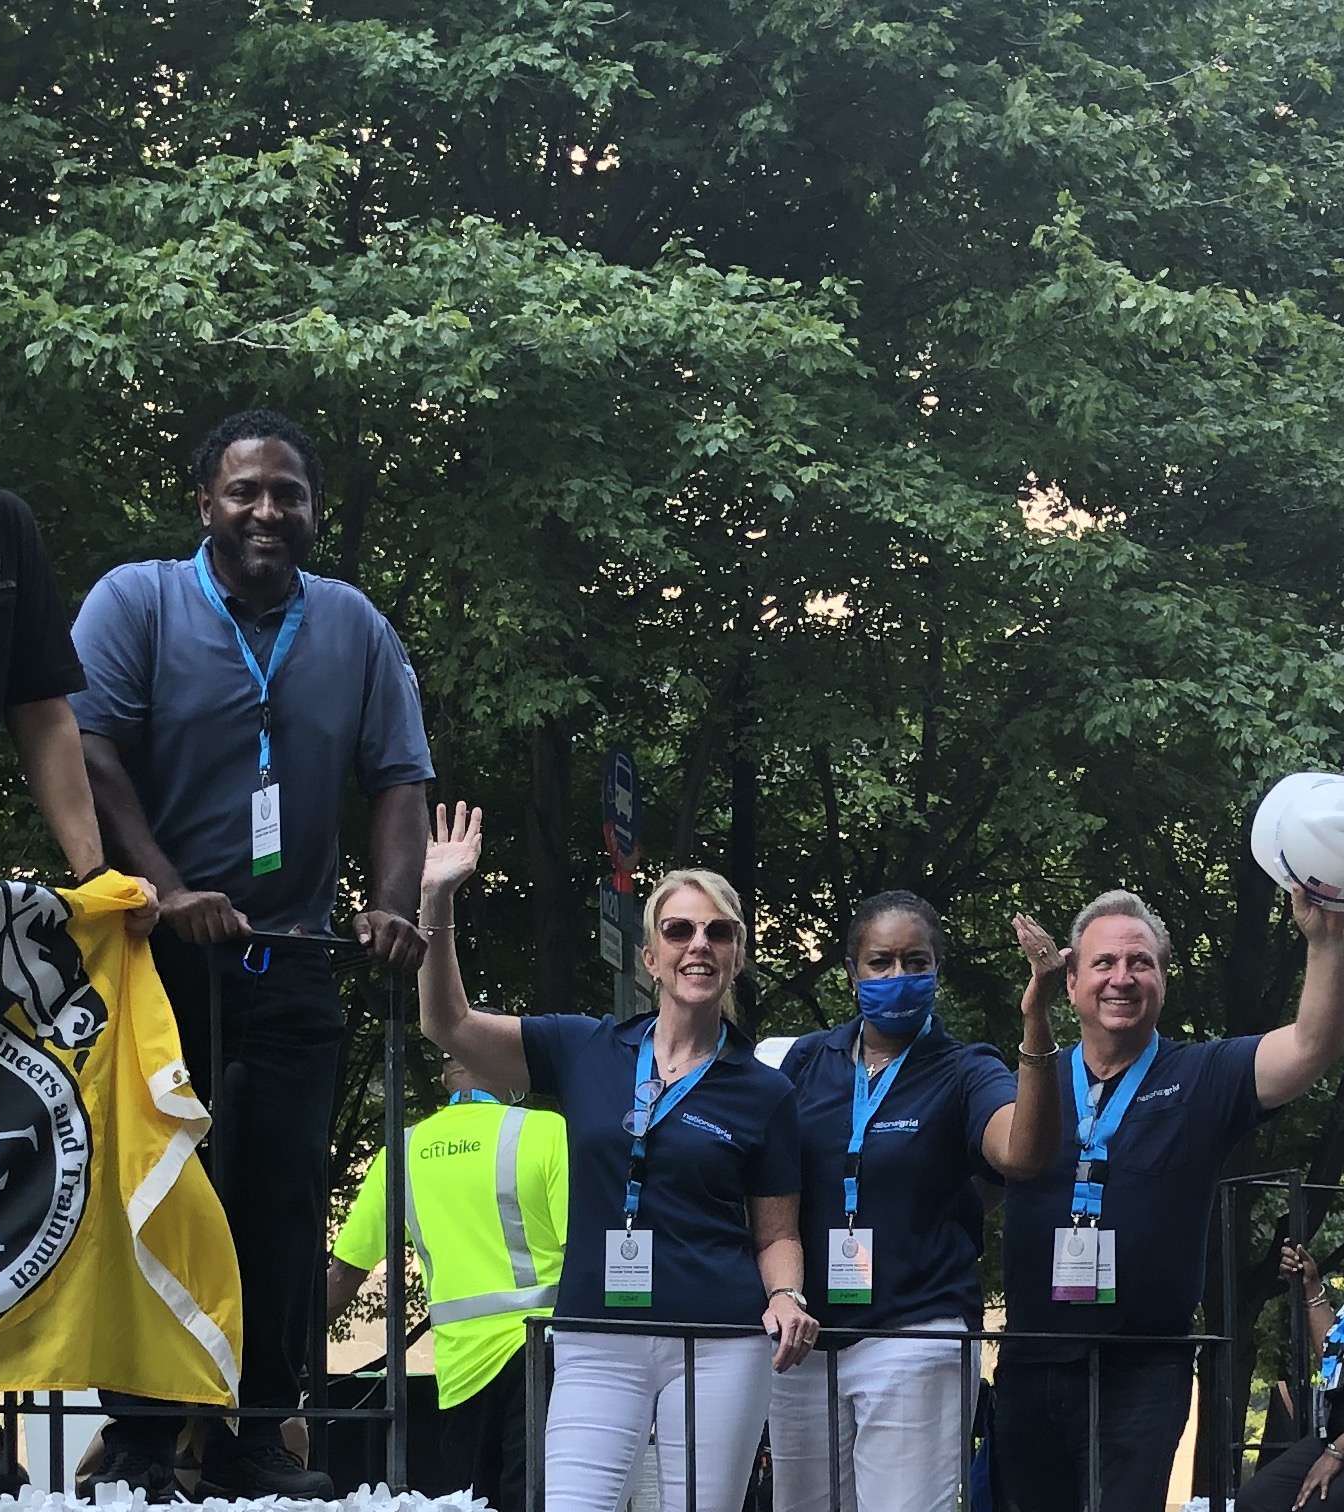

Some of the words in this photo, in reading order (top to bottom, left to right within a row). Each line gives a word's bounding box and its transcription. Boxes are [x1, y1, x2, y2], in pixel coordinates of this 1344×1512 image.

[52, 1103, 85, 1156] and
[872, 1118, 919, 1129] ationalgrid
[419, 1140, 446, 1160] citi
[447, 1139, 481, 1156] bike
[9, 1162, 84, 1290] Trainmen
